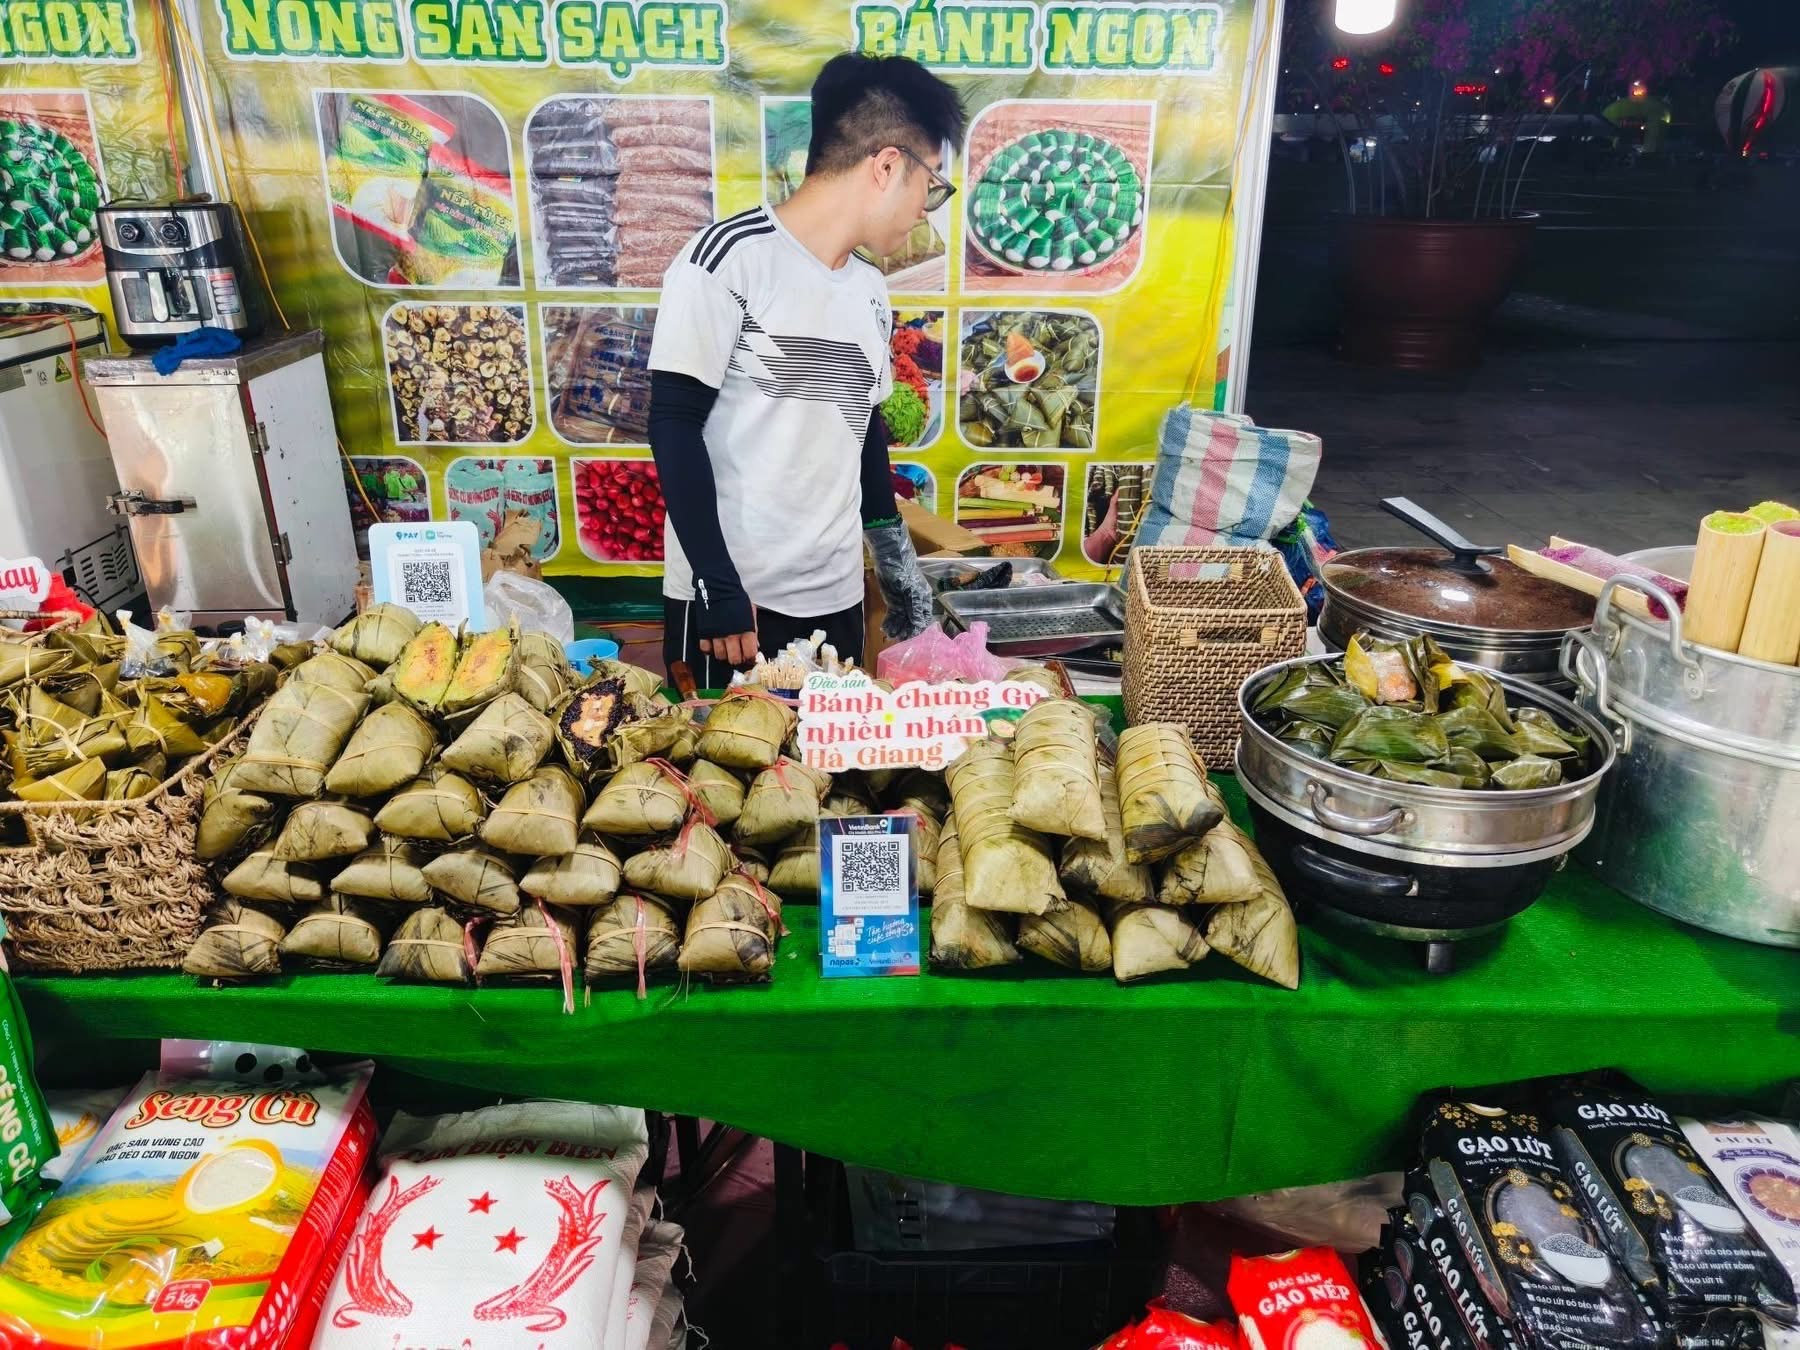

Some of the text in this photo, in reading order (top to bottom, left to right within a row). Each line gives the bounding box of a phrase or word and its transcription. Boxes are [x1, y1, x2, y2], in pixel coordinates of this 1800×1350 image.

[0, 1, 131, 54] GON
[560, 6, 720, 74] SẠCH
[1050, 12, 1215, 65] NGON
[0, 566, 39, 594] ay
[808, 673, 867, 691] Đặc sản
[808, 692, 884, 714] Bánh
[896, 686, 990, 710] chưng
[807, 714, 983, 745] nhiều nhân
[805, 741, 943, 770] Hà Giang
[250, 1091, 320, 1126] Cù
[1577, 1102, 1672, 1125] GẠO LỨT
[142, 1150, 166, 1159] CƠM
[168, 1151, 200, 1160] NGON
[152, 1136, 180, 1146] VÙNG
[183, 1138, 205, 1146] CAO
[1458, 1134, 1553, 1160] GẠO LỨT
[1575, 1161, 1599, 1199] GẠO
[1447, 1198, 1467, 1237] GẠO
[1258, 1278, 1350, 1315] GẠO NẾP
[1431, 1237, 1488, 1342] GẠO LỨT
[1413, 1283, 1442, 1337] GẠO
[1403, 1311, 1430, 1350] GẠ
